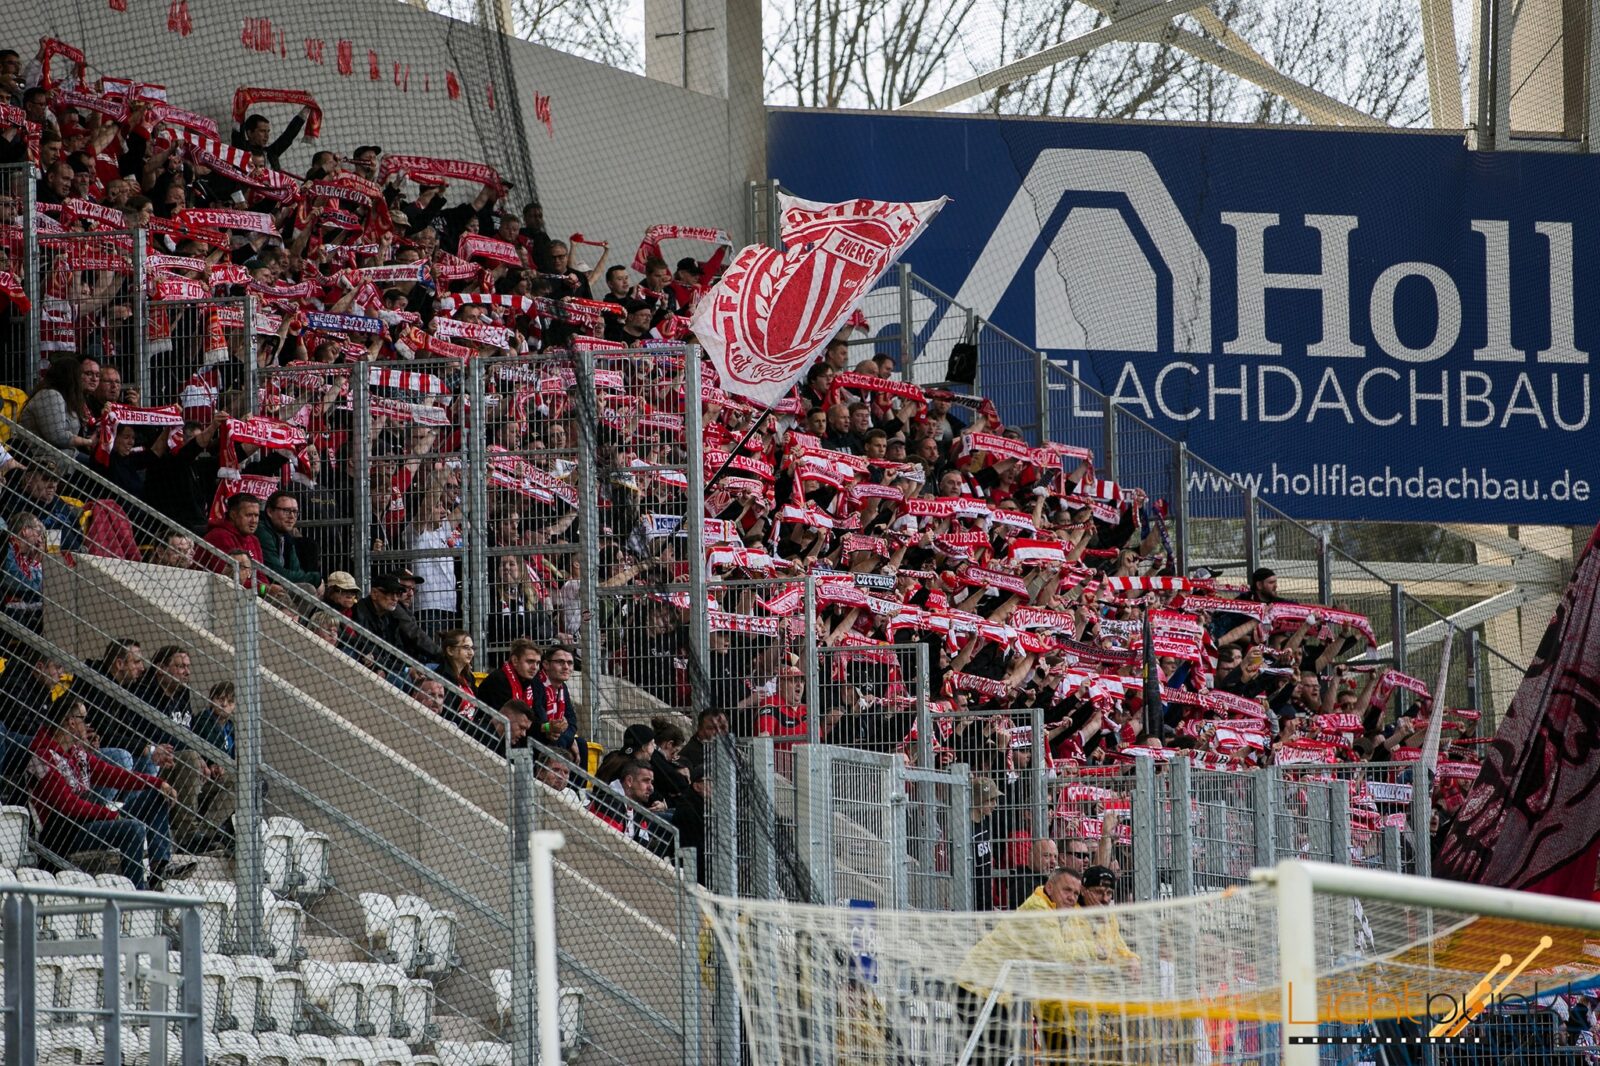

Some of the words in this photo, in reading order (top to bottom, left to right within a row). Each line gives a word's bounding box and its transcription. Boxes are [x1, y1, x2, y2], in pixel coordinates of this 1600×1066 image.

[188, 212, 207, 224] FC
[207, 212, 264, 229] ENERGIE
[1220, 211, 1589, 363] Holl
[1046, 360, 1590, 431] FLACHDACHBAU
[1186, 463, 1590, 502] www.hollflachdachbau.de
[856, 574, 894, 589] COTTBUS
